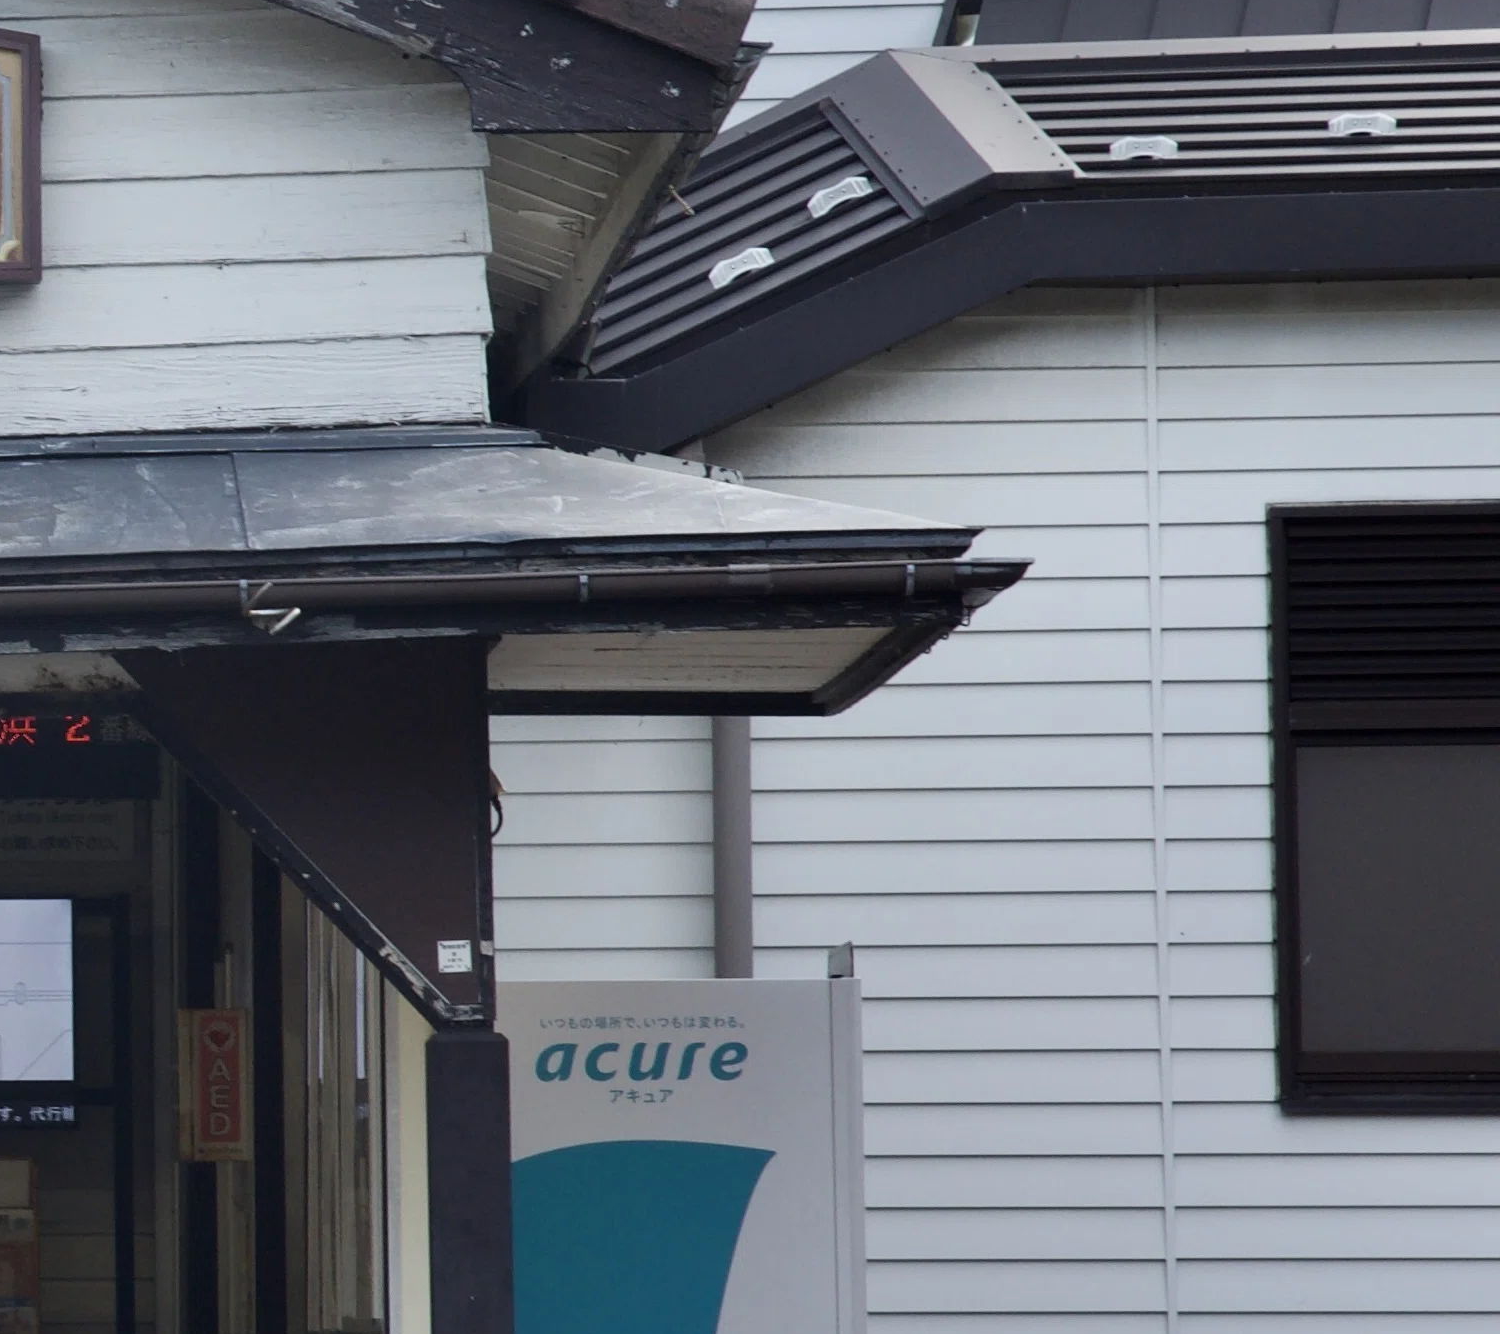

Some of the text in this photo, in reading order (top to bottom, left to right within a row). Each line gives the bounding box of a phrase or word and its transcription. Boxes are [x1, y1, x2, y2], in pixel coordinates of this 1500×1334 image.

[539, 1015, 746, 1030] いつもの場所で、いつもは変わる。
[534, 1041, 749, 1083] acure
[208, 1057, 232, 1136] AED
[609, 1088, 674, 1104] アキュア
